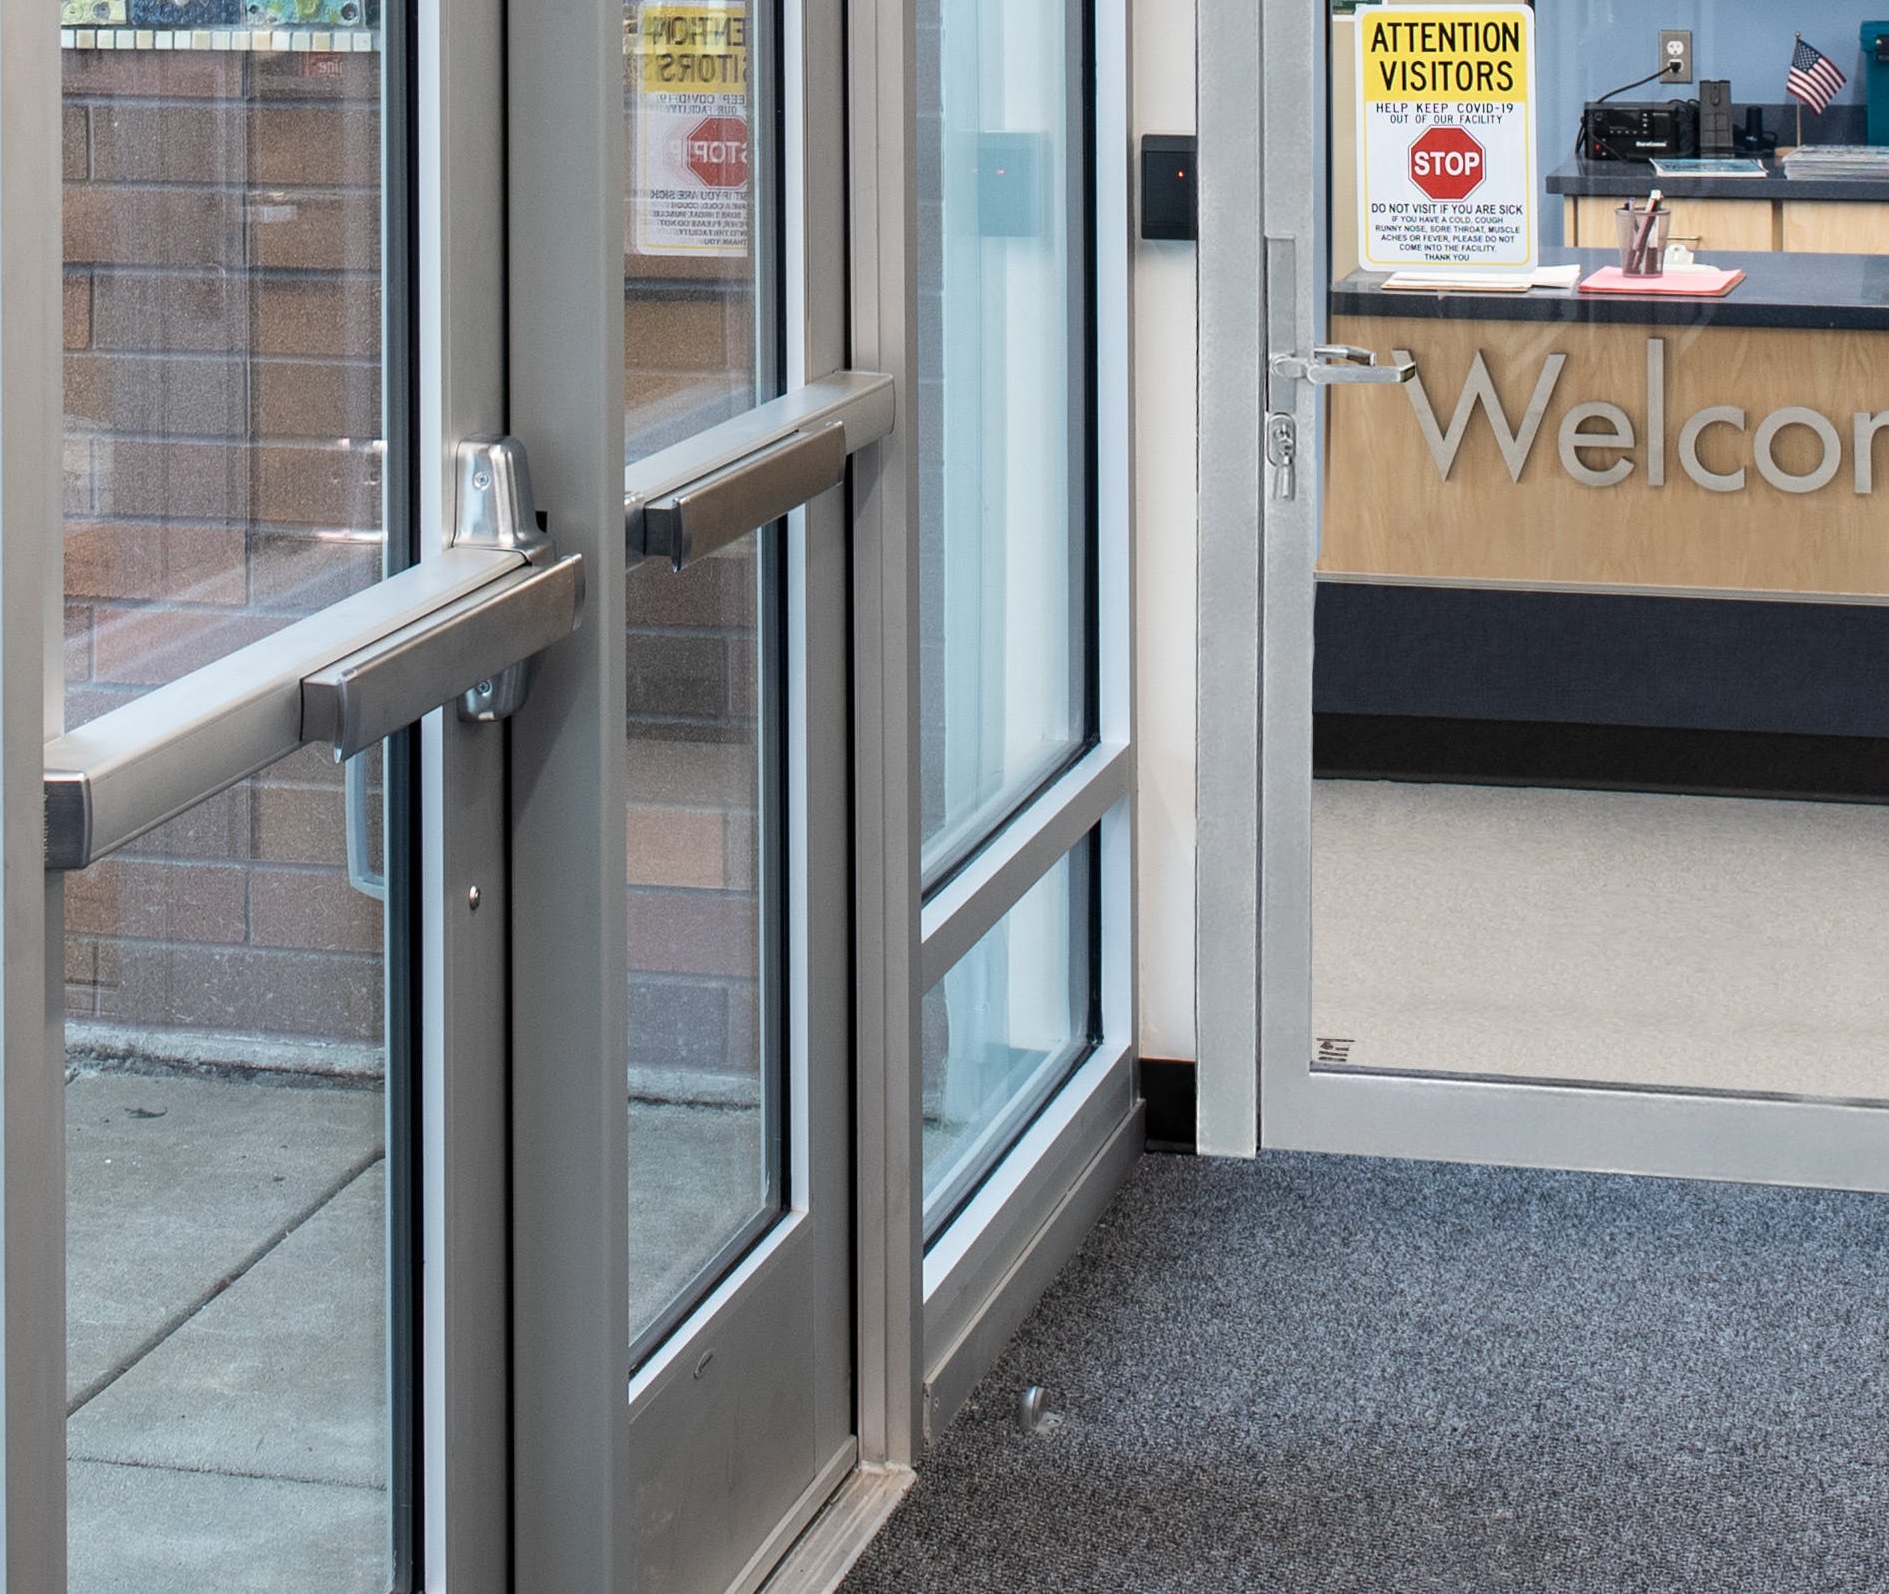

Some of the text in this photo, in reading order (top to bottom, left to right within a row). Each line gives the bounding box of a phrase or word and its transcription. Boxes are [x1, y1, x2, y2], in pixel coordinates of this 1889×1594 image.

[1371, 22, 1520, 52] ATTENTION
[1380, 61, 1513, 91] VISITORS
[1377, 103, 1513, 113] HELP KEEP COVID-19
[1390, 115, 1502, 124] OUT OF OUR FACILITY
[1414, 151, 1480, 176] STOP
[1371, 204, 1523, 214] DO NOT VISIT IF YOU ARE SICK
[1404, 225, 1428, 233] NOSE,
[1423, 235, 1450, 243] FEVER,
